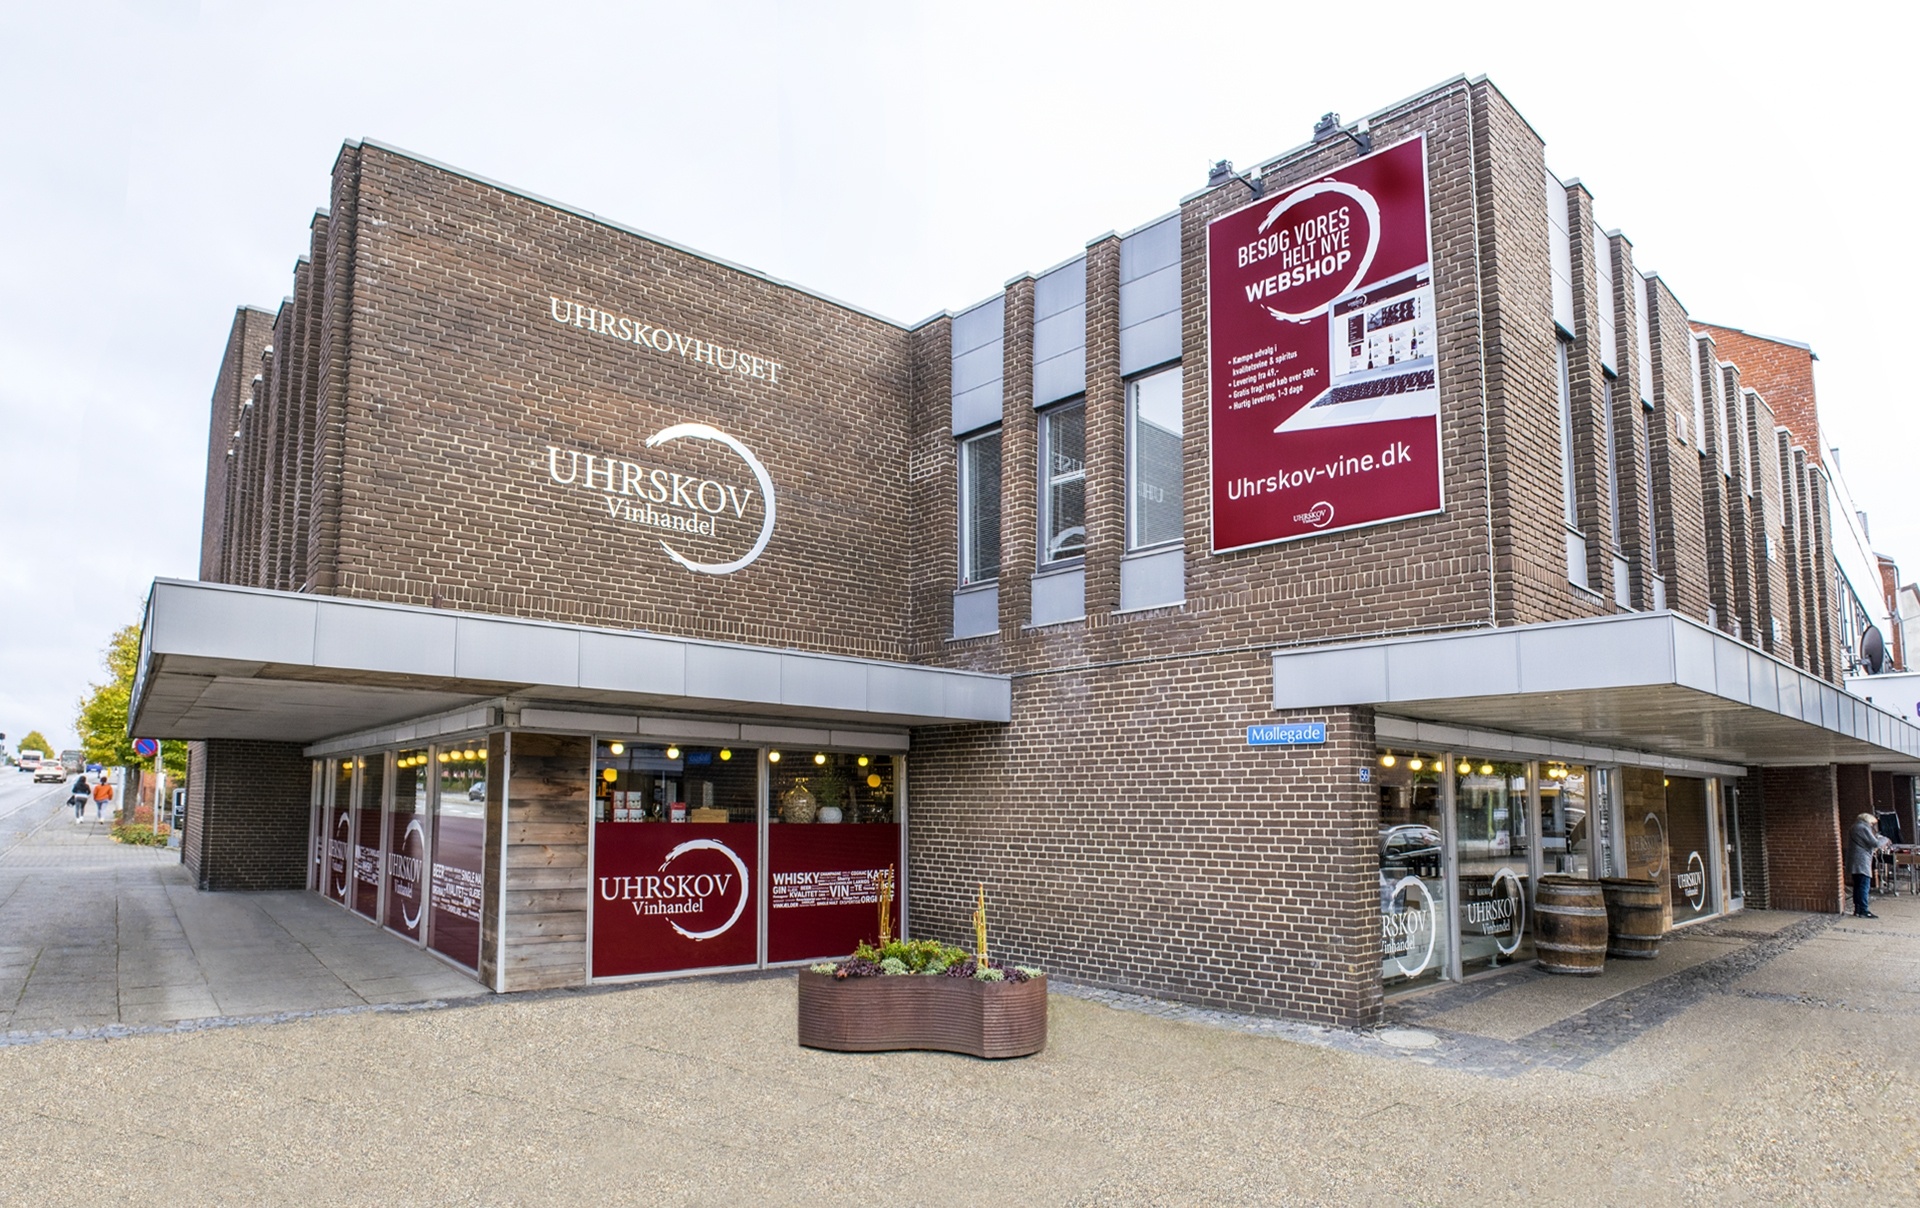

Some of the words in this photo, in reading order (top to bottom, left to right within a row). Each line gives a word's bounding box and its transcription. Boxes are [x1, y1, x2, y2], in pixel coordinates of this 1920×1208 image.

[1238, 229, 1290, 268] BESØG
[1294, 206, 1350, 245] VORES
[1283, 240, 1317, 270] HELT
[1321, 227, 1350, 256] NYE
[1245, 249, 1351, 303] WEBSHOP
[550, 296, 781, 384] UHRSKOVHUSET
[1232, 353, 1253, 365] Kæmpe
[1254, 346, 1273, 358] udvalg
[1232, 360, 1268, 376] kvalitetsvine
[1269, 356, 1274, 365] &
[1275, 350, 1297, 364] spiritus
[1233, 375, 1257, 388] Levering
[1258, 372, 1266, 380] fra
[1233, 387, 1250, 399] Gratis
[1251, 384, 1265, 394] fragt
[1265, 379, 1276, 389] ved
[1277, 376, 1288, 386] køb
[1289, 373, 1302, 382] over
[1233, 399, 1251, 410] Hurtig
[1277, 387, 1288, 397] 1-3
[1289, 384, 1303, 395] dage
[546, 445, 753, 519] UHRSKOV
[1228, 441, 1411, 500] Uhrskov-vine.dk
[604, 496, 716, 537] Vinhandel
[1293, 509, 1326, 522] UHRSKOV
[1252, 725, 1320, 743] Møllegade
[388, 853, 422, 883] UHRSKOV
[773, 872, 820, 885] WHISKY
[1677, 871, 1702, 889] UHRSKOV
[599, 873, 733, 901] UHRSKOV
[773, 886, 787, 895] GIN
[829, 884, 850, 898] VIN
[855, 884, 863, 892] TE
[789, 890, 818, 898] KVALITET
[632, 898, 704, 916] Vinhandel
[1467, 897, 1519, 924] UHRSKOV
[1381, 910, 1427, 938] RSKOV
[1482, 919, 1511, 935] Vinhandel
